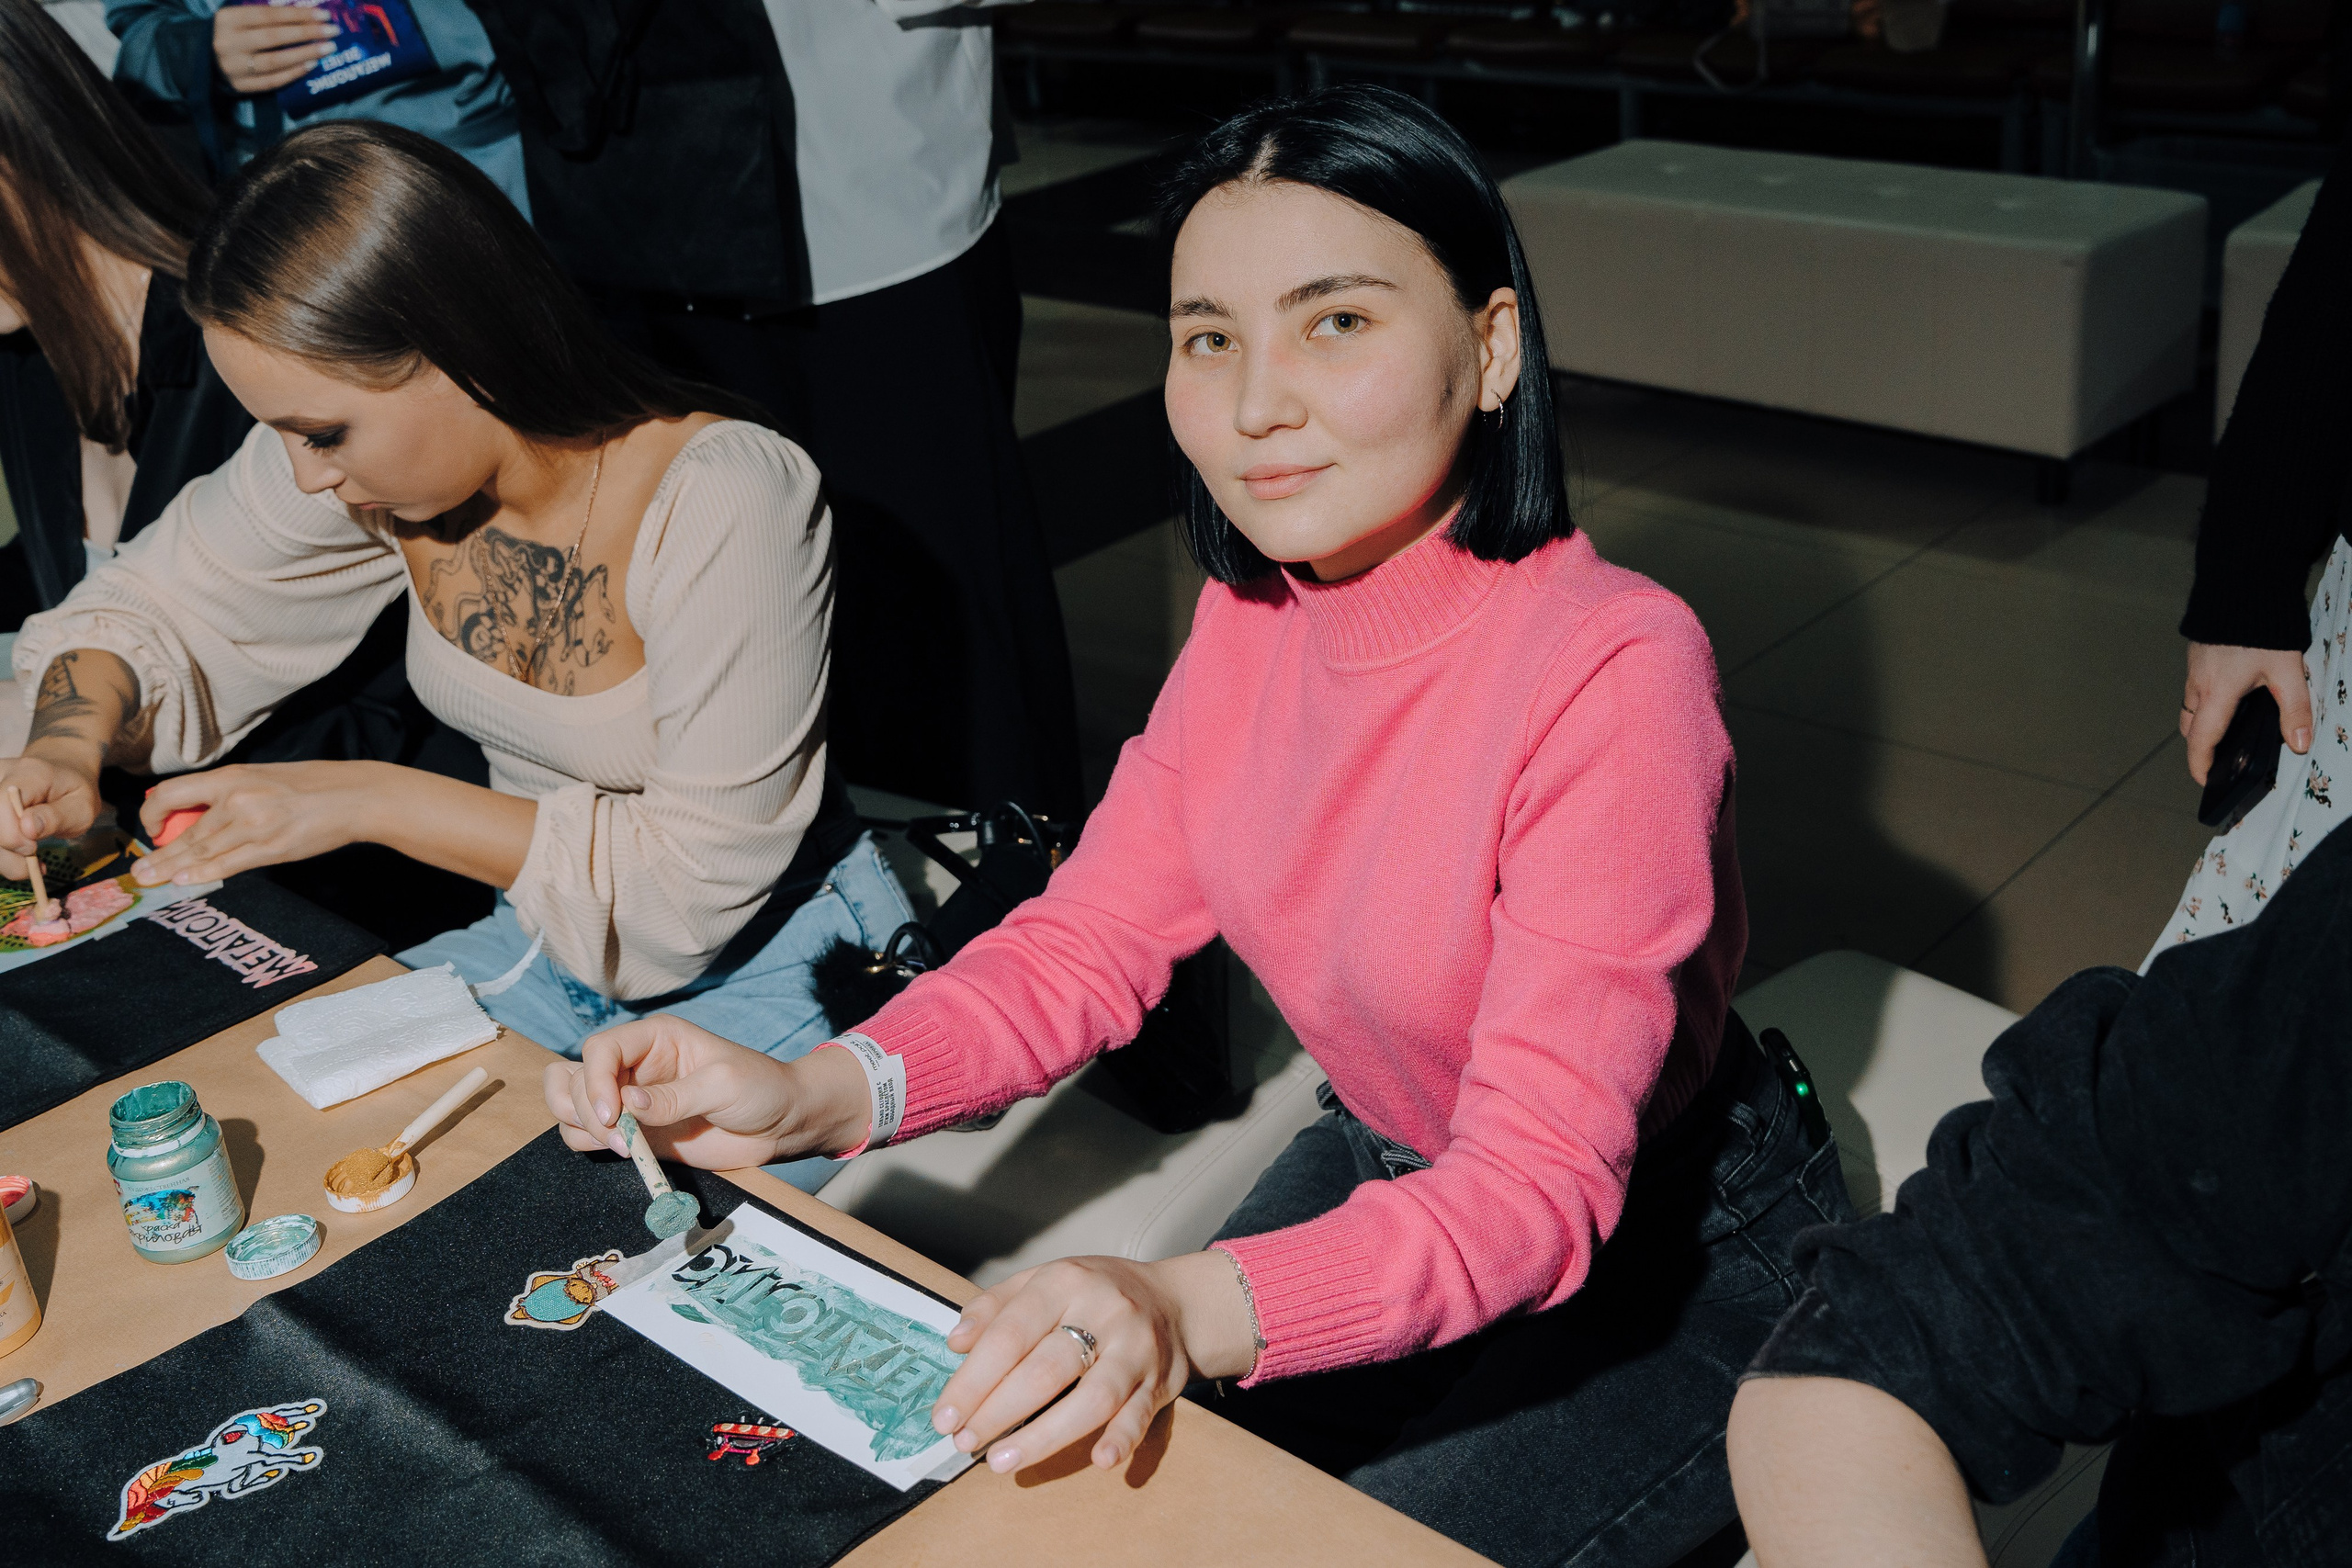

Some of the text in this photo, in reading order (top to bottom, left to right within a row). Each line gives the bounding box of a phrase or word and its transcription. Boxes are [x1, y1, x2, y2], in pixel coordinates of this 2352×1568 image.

[876, 1086, 885, 1110] СЕГОДНЯ
[882, 1082, 890, 1111] БРАСЛЕТОМ
[887, 1077, 897, 1124] СВОБОДНЫЙ ВХОД
